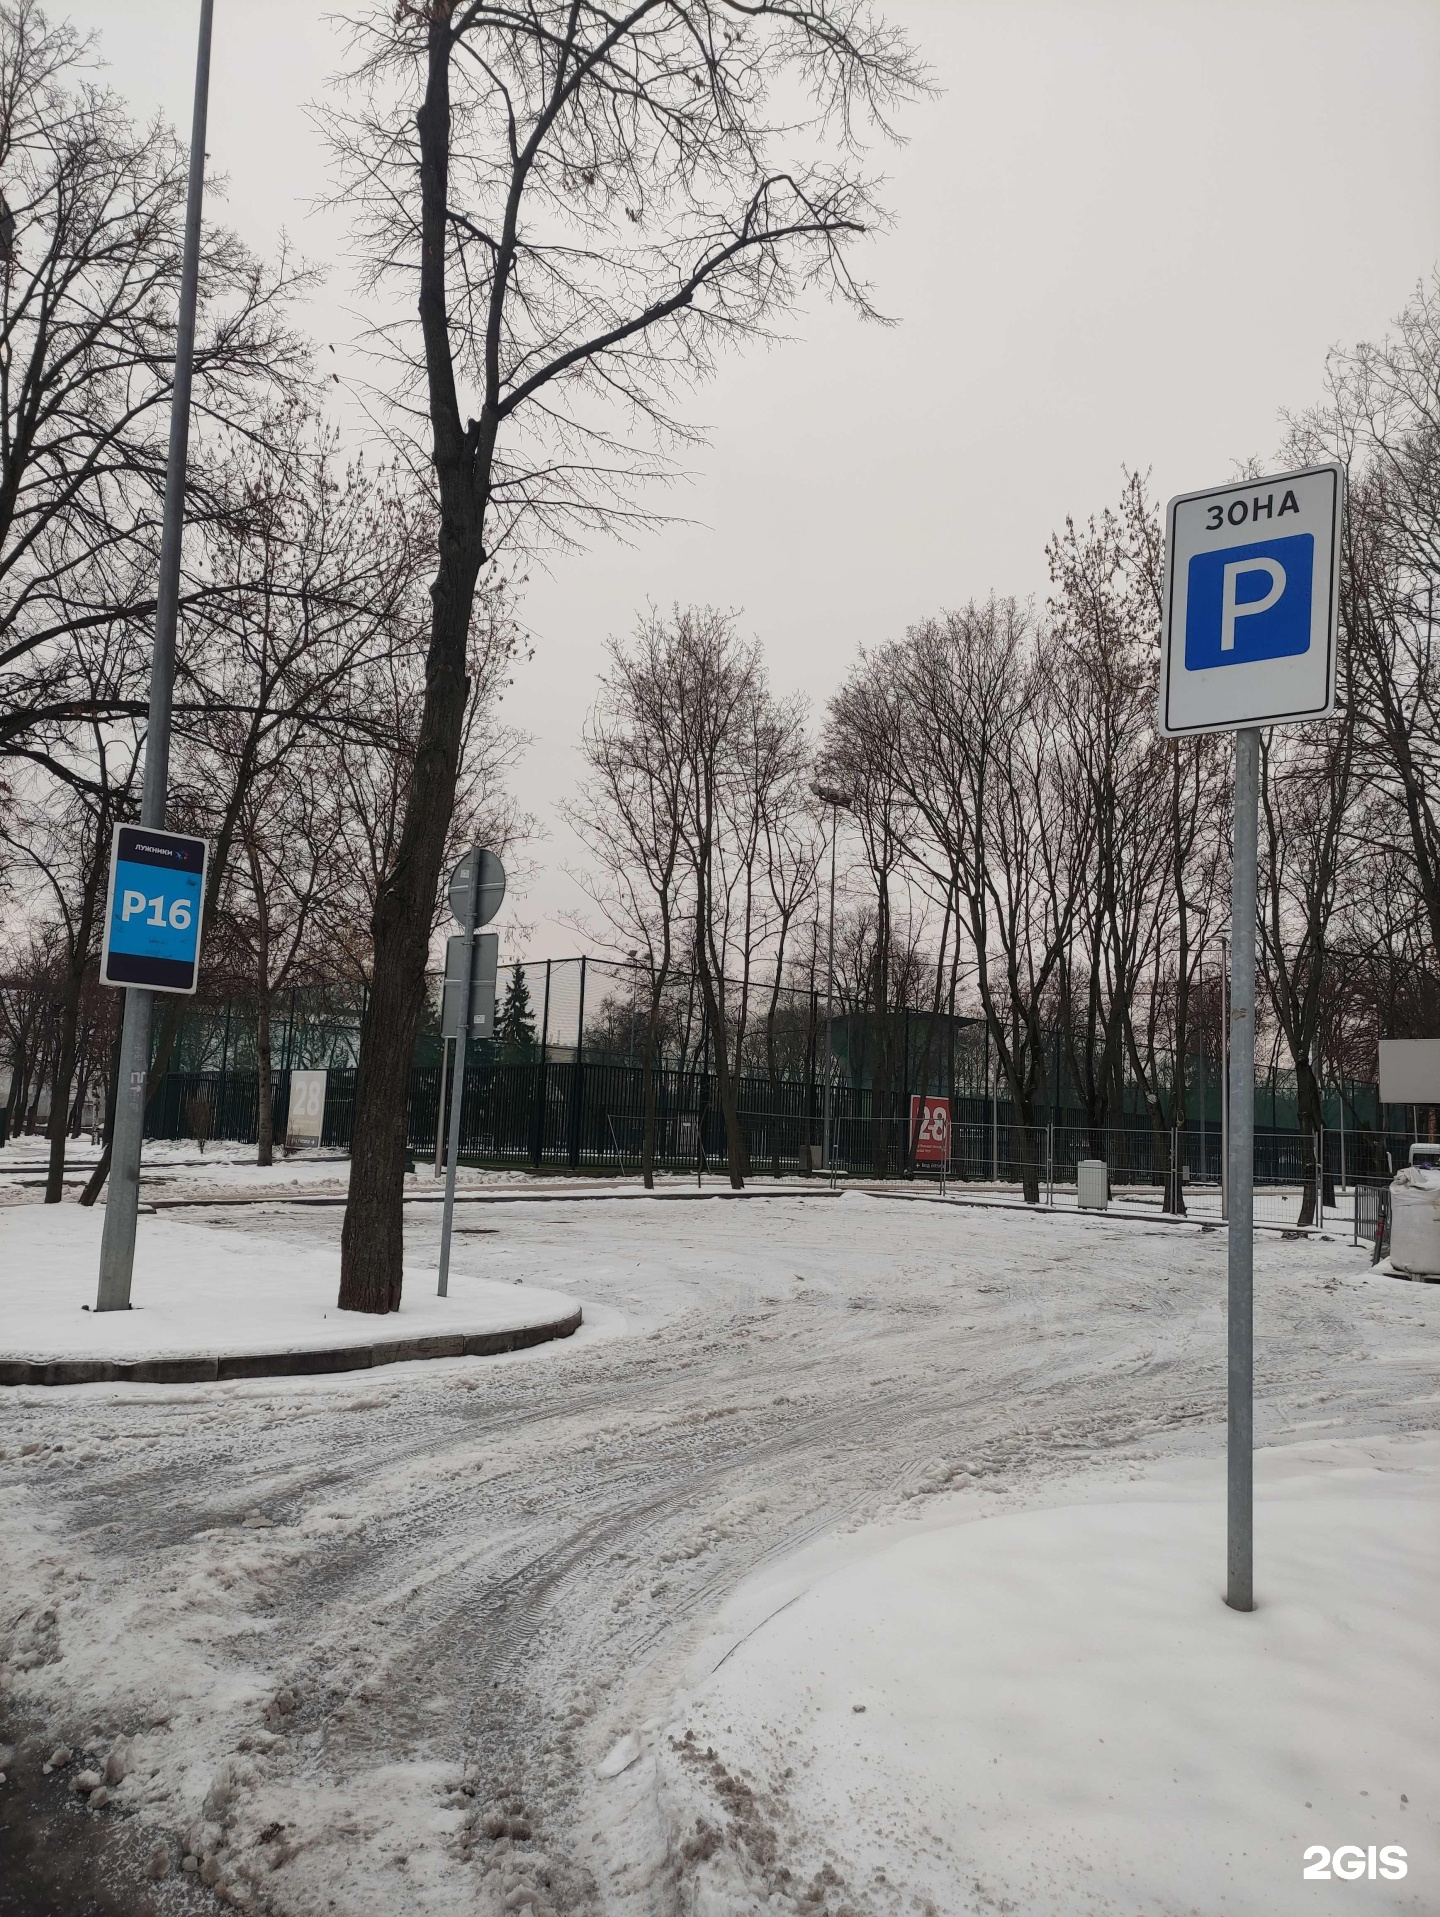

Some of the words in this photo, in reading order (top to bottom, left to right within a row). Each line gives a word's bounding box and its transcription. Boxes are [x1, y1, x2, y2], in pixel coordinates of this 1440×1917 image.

[1205, 490, 1300, 531] ЗОНА
[1220, 557, 1287, 652] P
[135, 844, 173, 856] ЛУЖНИКИ
[121, 889, 192, 930] P16
[292, 1081, 321, 1116] 28
[917, 1106, 947, 1142] 28
